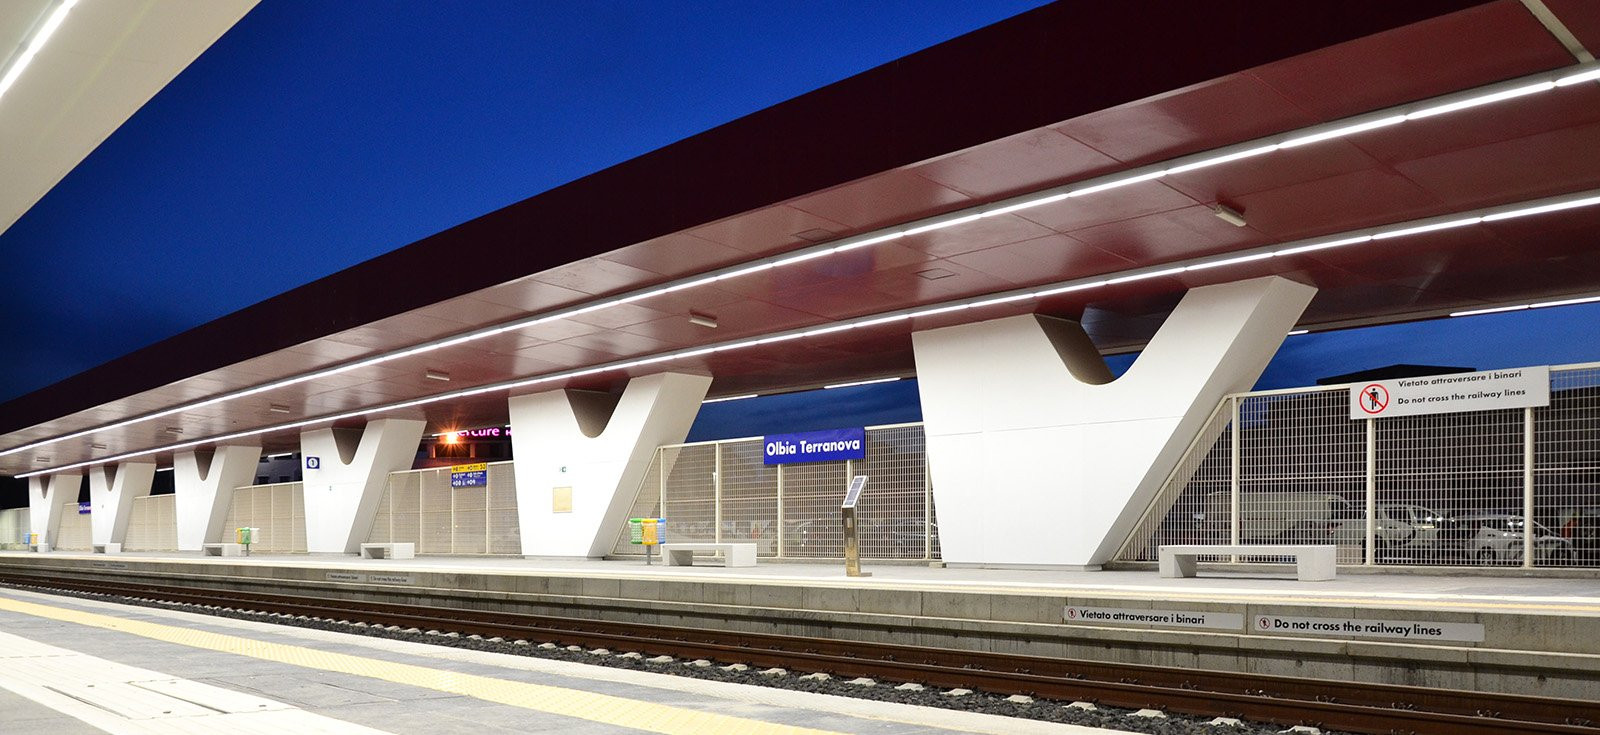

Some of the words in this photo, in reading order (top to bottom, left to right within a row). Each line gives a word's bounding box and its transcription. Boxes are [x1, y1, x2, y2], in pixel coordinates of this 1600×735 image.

[1398, 379, 1429, 388] Vietato
[1431, 375, 1486, 385] attraversare
[1494, 370, 1522, 379] binari
[1398, 397, 1409, 405] Do
[1411, 396, 1426, 404] not
[1427, 394, 1449, 403] cross
[1451, 392, 1466, 401] the
[1468, 391, 1502, 399] railway
[1504, 388, 1526, 397] lines
[766, 441, 797, 456] Olbia
[800, 440, 860, 454] Terranova
[1080, 610, 1111, 620] Vietato
[1113, 612, 1169, 623] attraversare
[1171, 614, 1174, 623] i
[1176, 614, 1205, 625] binari
[1274, 619, 1289, 629] Do
[1292, 621, 1310, 630] not
[1312, 622, 1341, 631] cross
[1343, 622, 1362, 632] the
[1365, 623, 1411, 637] railway
[1413, 625, 1442, 636] lines
